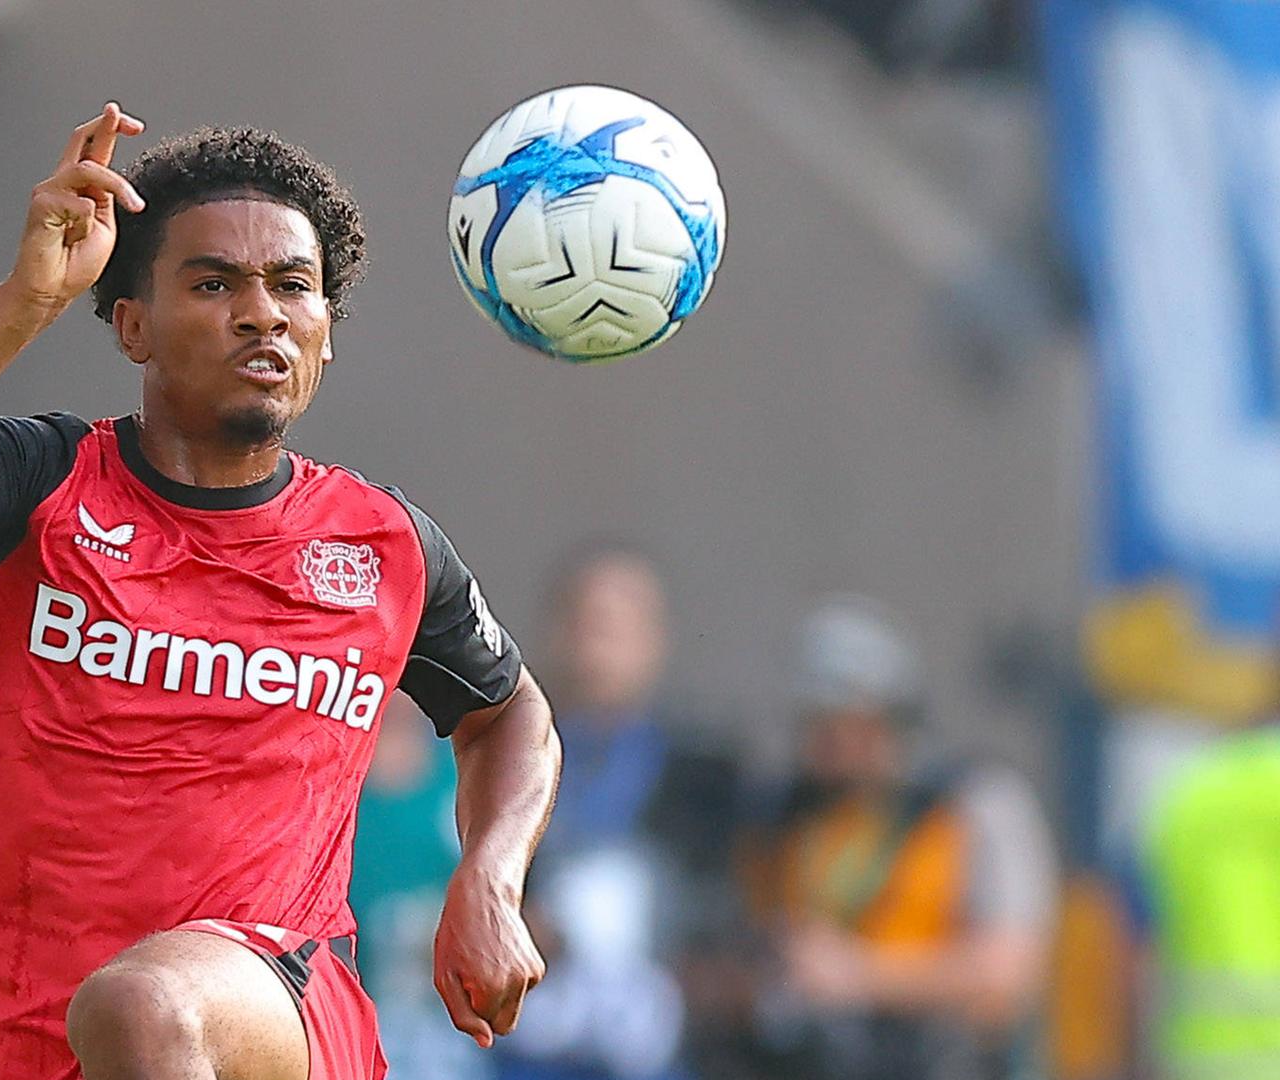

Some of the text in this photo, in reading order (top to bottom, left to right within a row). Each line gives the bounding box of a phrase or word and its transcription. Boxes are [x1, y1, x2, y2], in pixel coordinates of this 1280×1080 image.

[73, 533, 131, 563] CASTORE
[325, 571, 358, 583] BAYER
[29, 583, 385, 732] Barmenia
